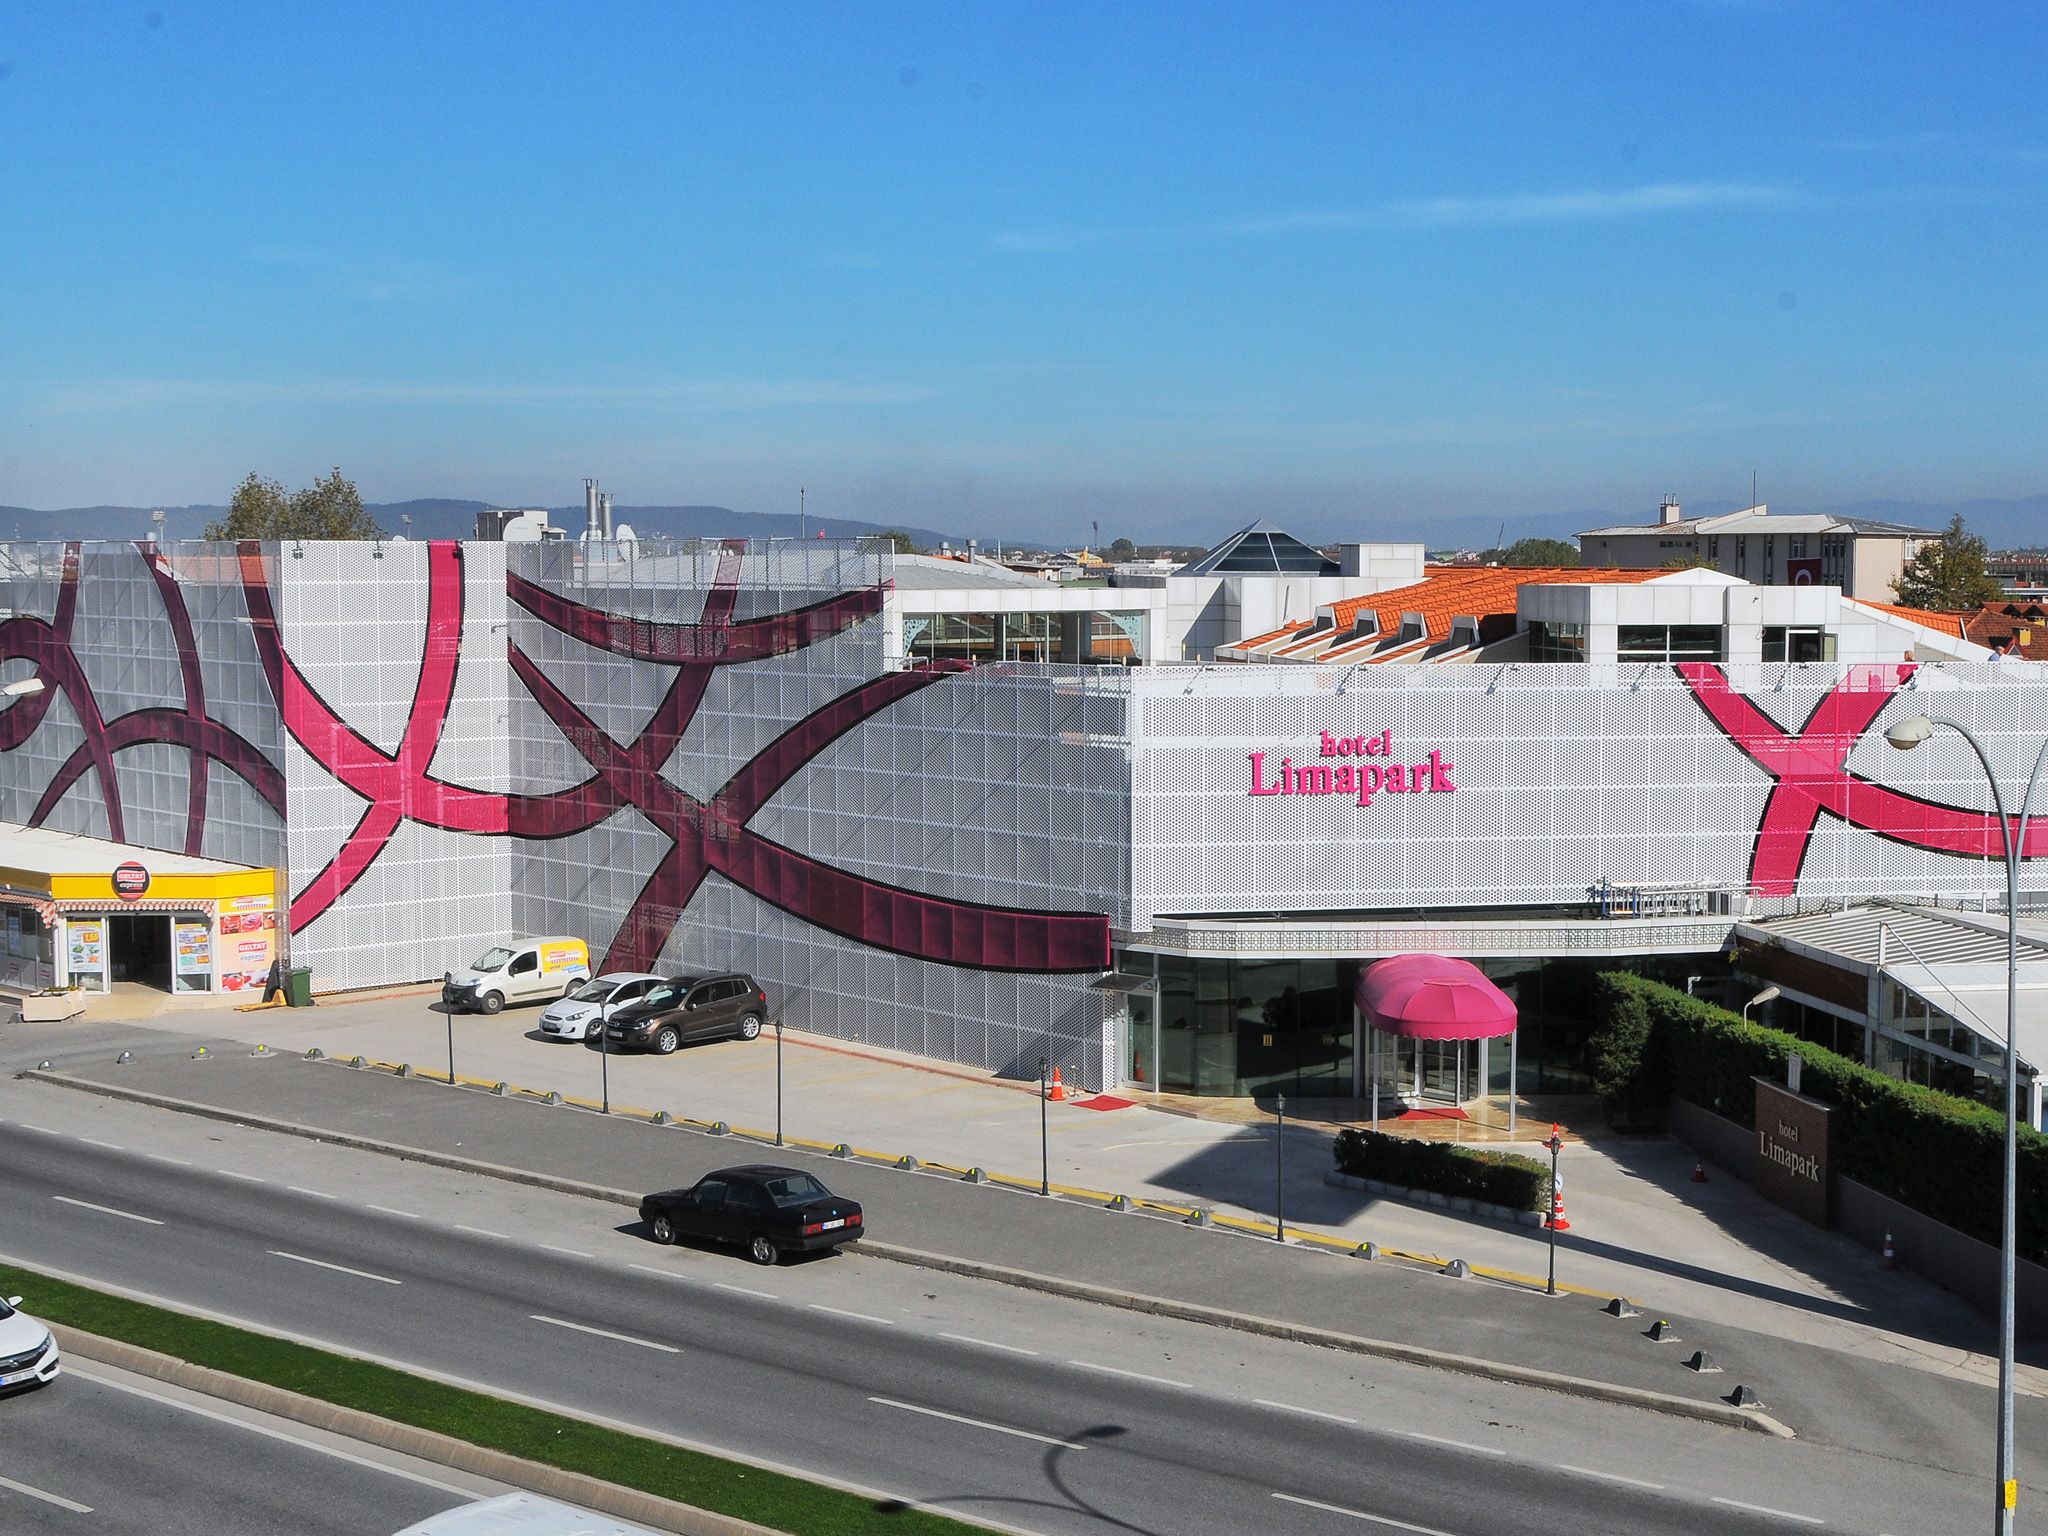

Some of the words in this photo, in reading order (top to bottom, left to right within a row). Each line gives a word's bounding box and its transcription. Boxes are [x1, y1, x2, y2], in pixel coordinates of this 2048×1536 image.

[1320, 728, 1392, 757] hotel
[1249, 749, 1458, 807] Limapark
[239, 942, 266, 951] GELTAT
[240, 953, 265, 961] express
[1778, 1119, 1798, 1142] hotel
[1759, 1131, 1819, 1182] Limapark
